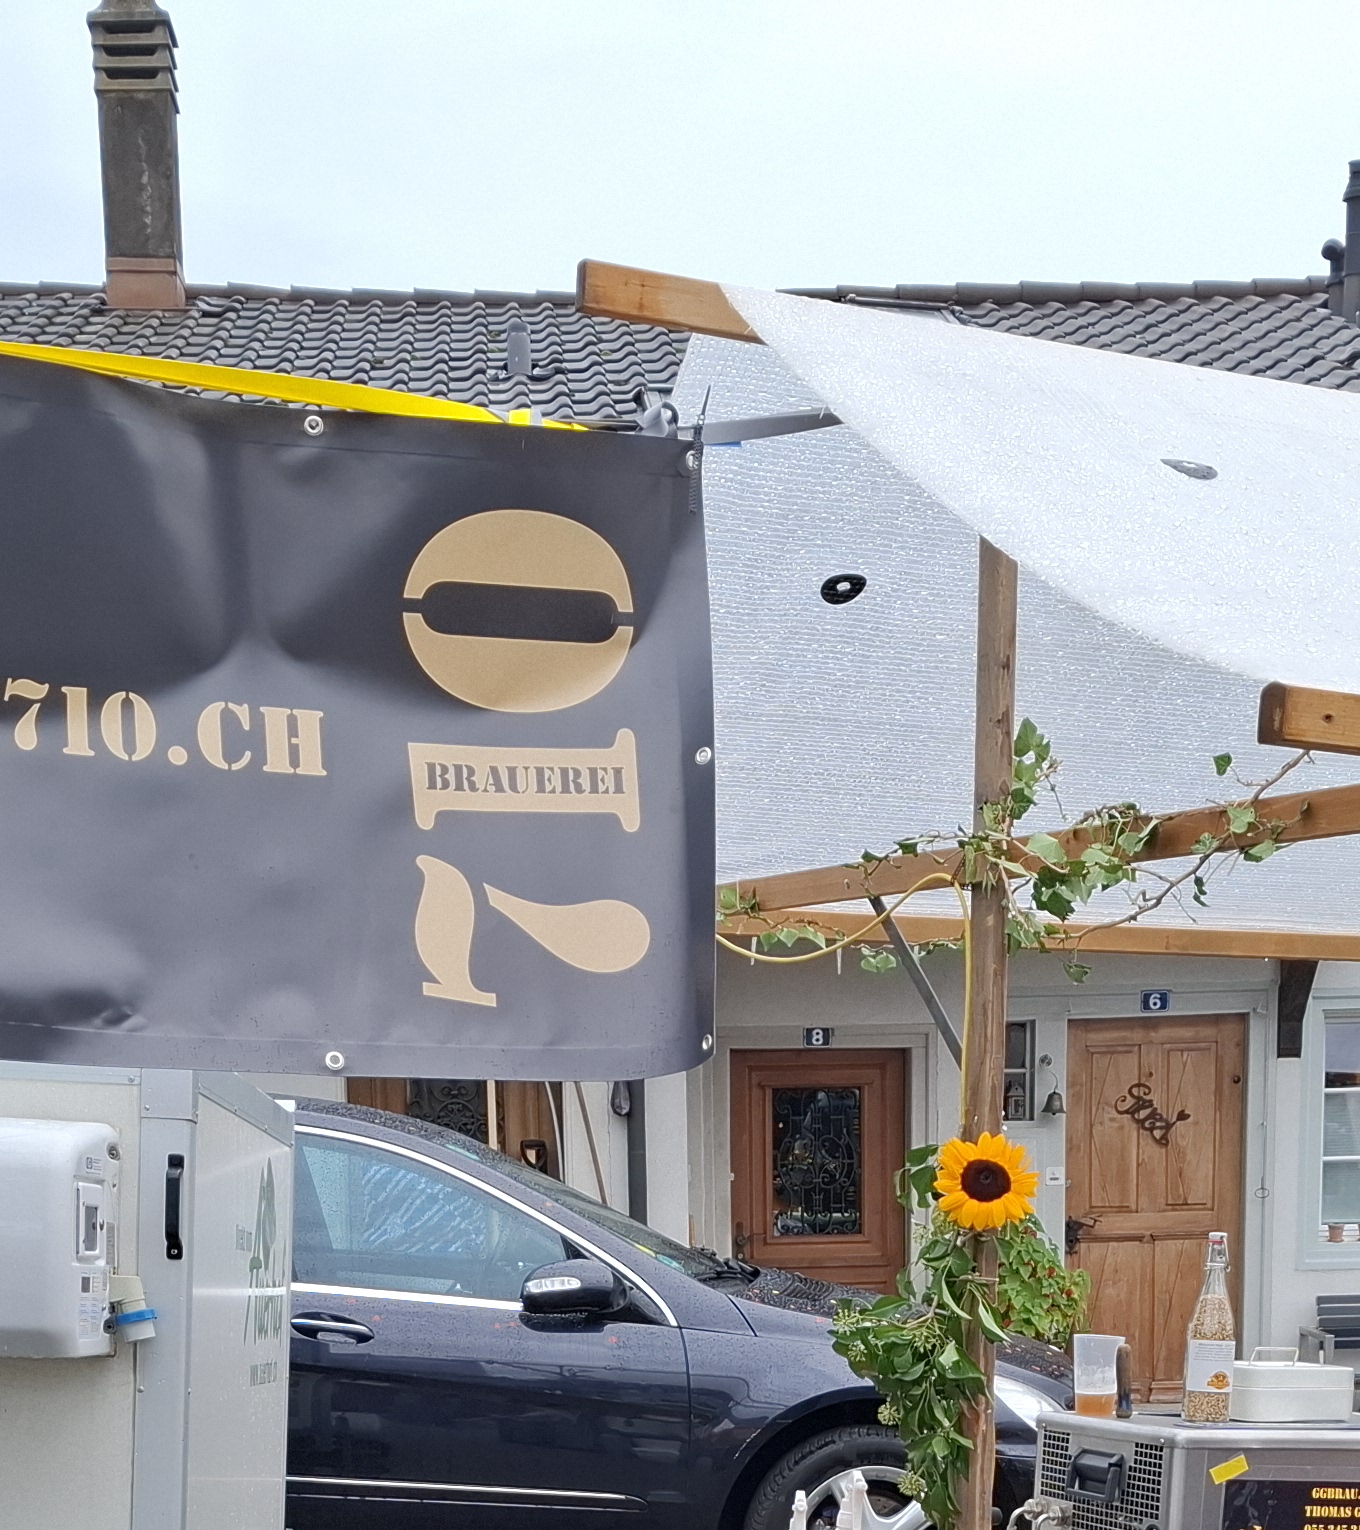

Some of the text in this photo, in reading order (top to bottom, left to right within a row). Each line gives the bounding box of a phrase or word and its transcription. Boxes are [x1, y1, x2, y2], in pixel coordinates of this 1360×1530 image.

[424, 761, 626, 795] BRAUEREI
[1149, 993, 1162, 1010] 6
[811, 1028, 824, 1046] 8
[1304, 1505, 1352, 1519] THOMAS
